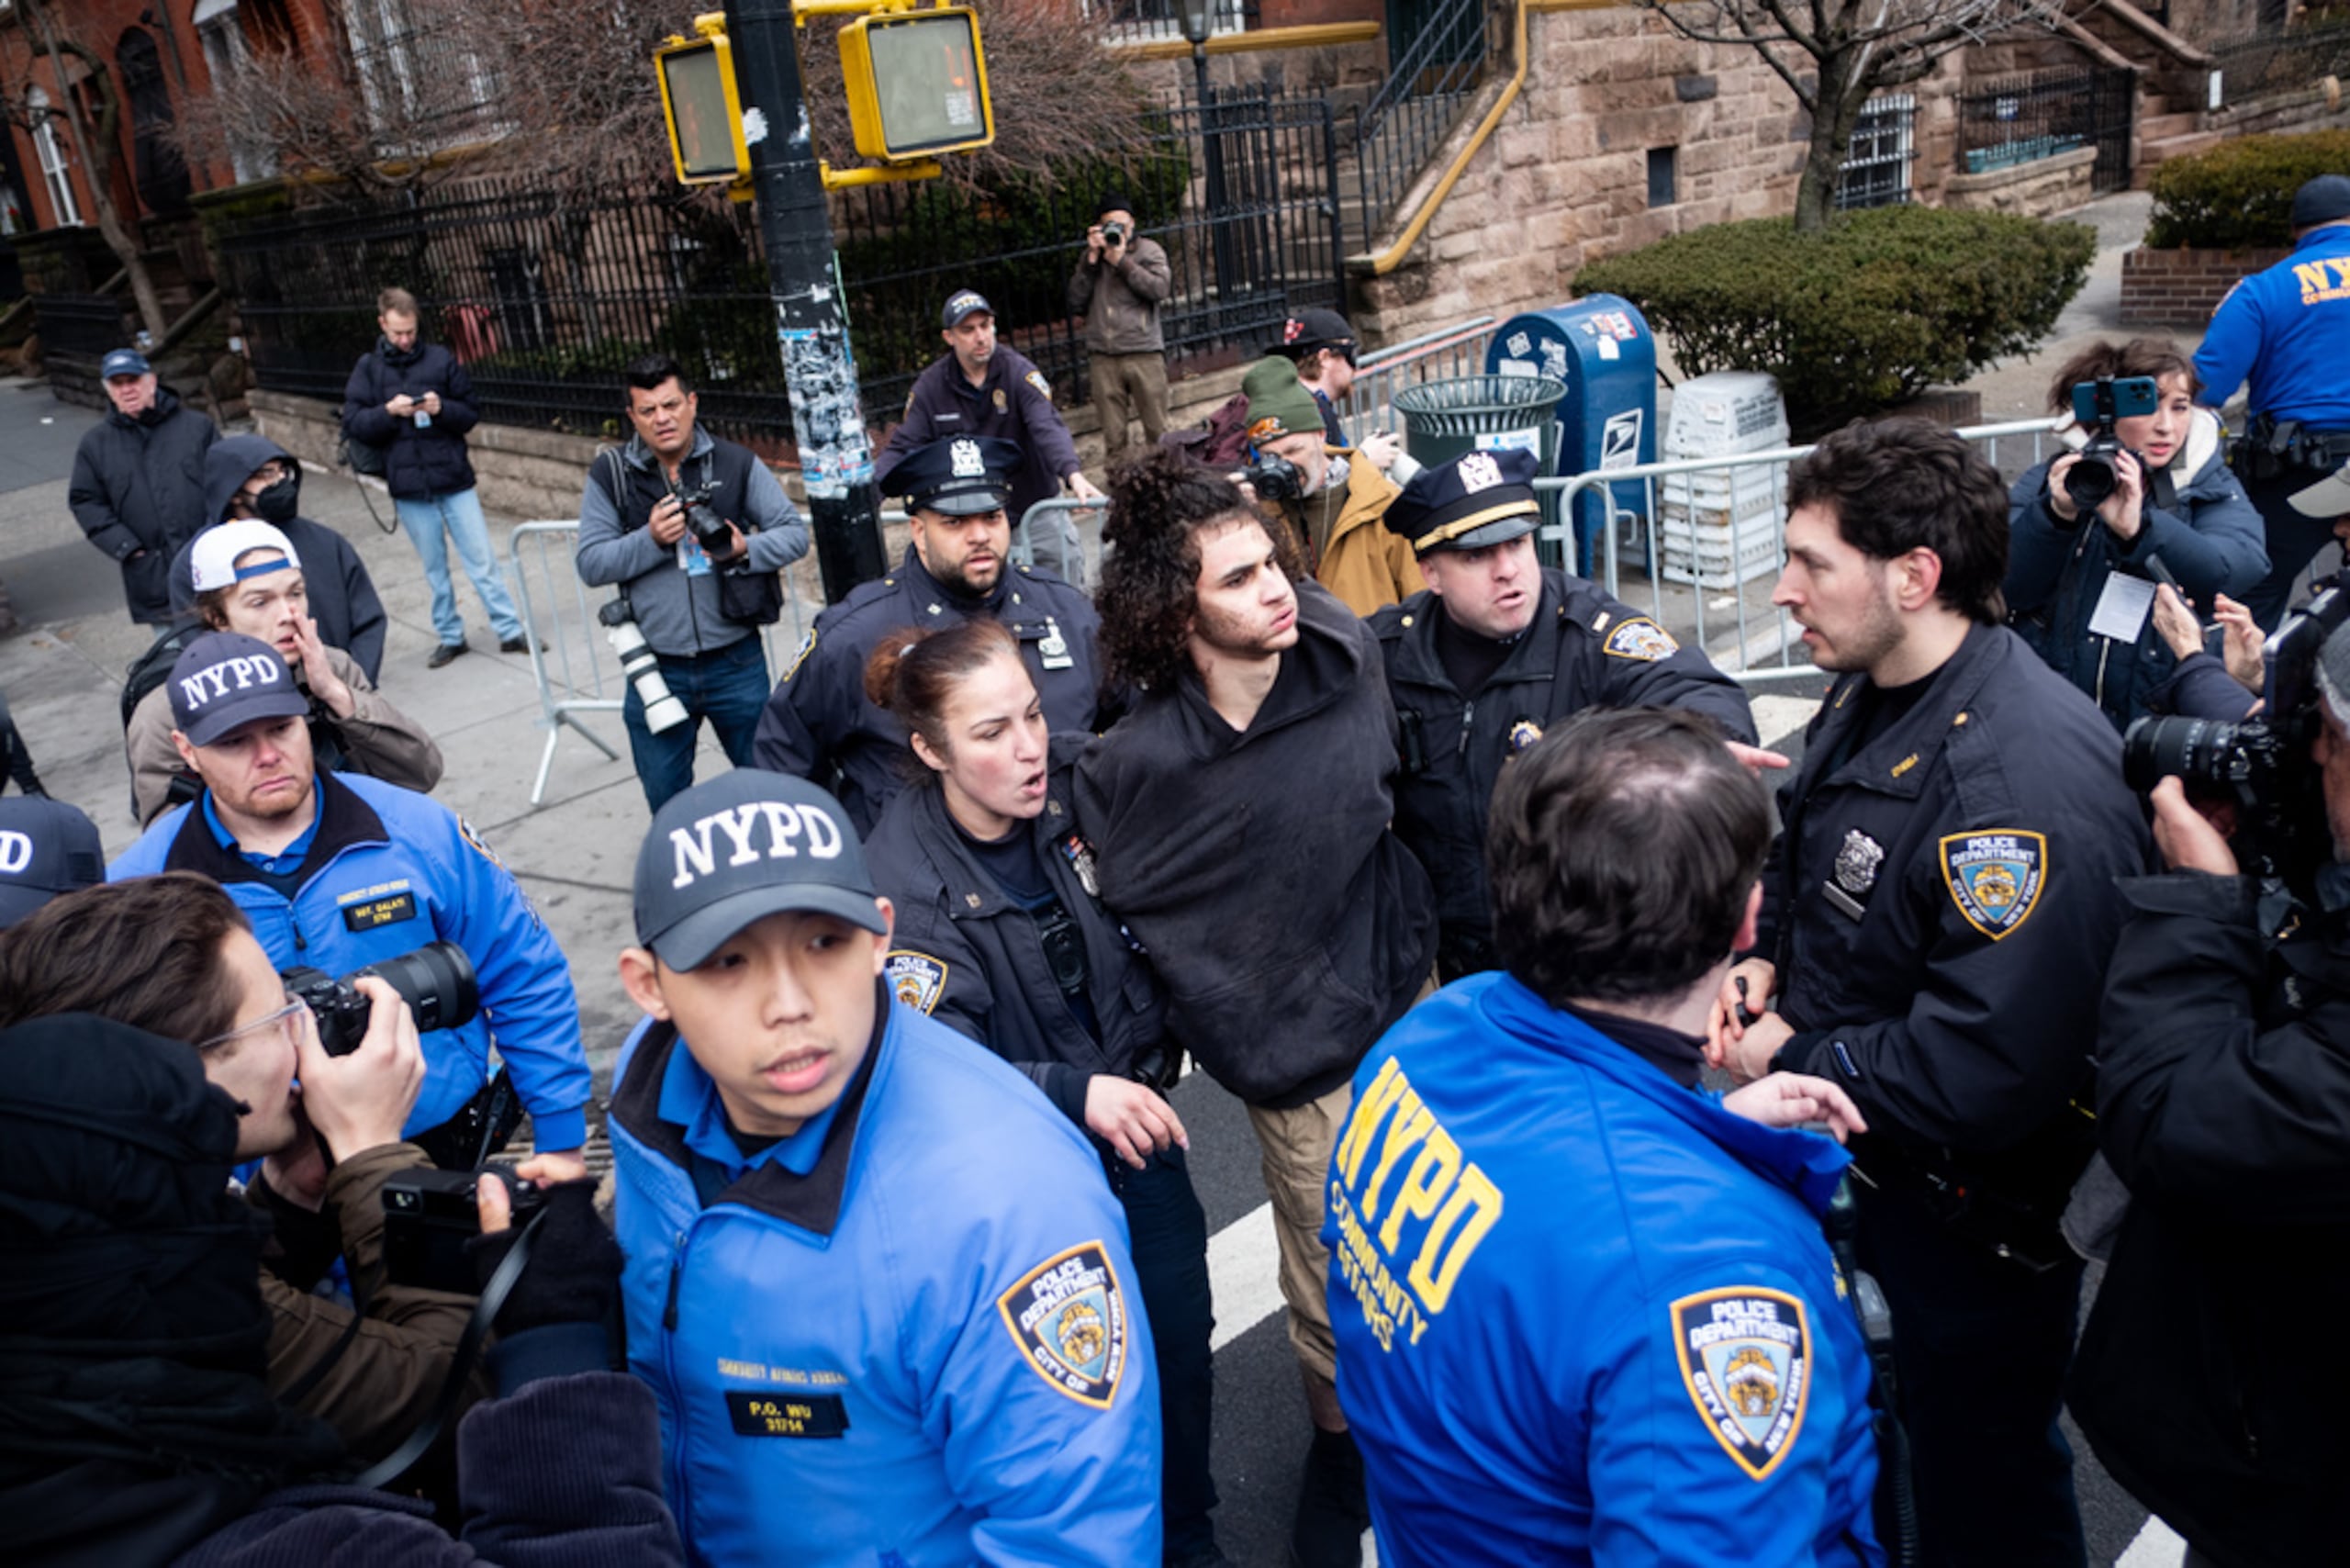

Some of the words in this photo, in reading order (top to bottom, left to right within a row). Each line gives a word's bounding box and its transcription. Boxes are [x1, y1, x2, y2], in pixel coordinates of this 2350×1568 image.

[179, 654, 279, 711] NYPD
[669, 801, 843, 890] NYPD
[1951, 848, 2035, 867] DEPARTMENT
[1967, 836, 2018, 851] POLICE
[1953, 879, 1973, 906] CITY
[1337, 1055, 1504, 1314] NYPD
[1031, 1256, 1086, 1301] POLICE
[1332, 1181, 1428, 1346] COMMUNITY
[1020, 1265, 1107, 1332] DEPARTMENT
[1711, 1299, 1777, 1322] POLICE
[1690, 1318, 1799, 1350] DEPARTMENT
[1034, 1345, 1066, 1377] CITY
[1066, 1373, 1090, 1393] OF
[748, 1401, 781, 1417] P.O.
[786, 1404, 811, 1419] WU
[1694, 1371, 1726, 1417] CITY
[1719, 1417, 1747, 1449] OF
[1764, 1412, 1791, 1454] NEW
[1784, 1358, 1804, 1411] YORK
